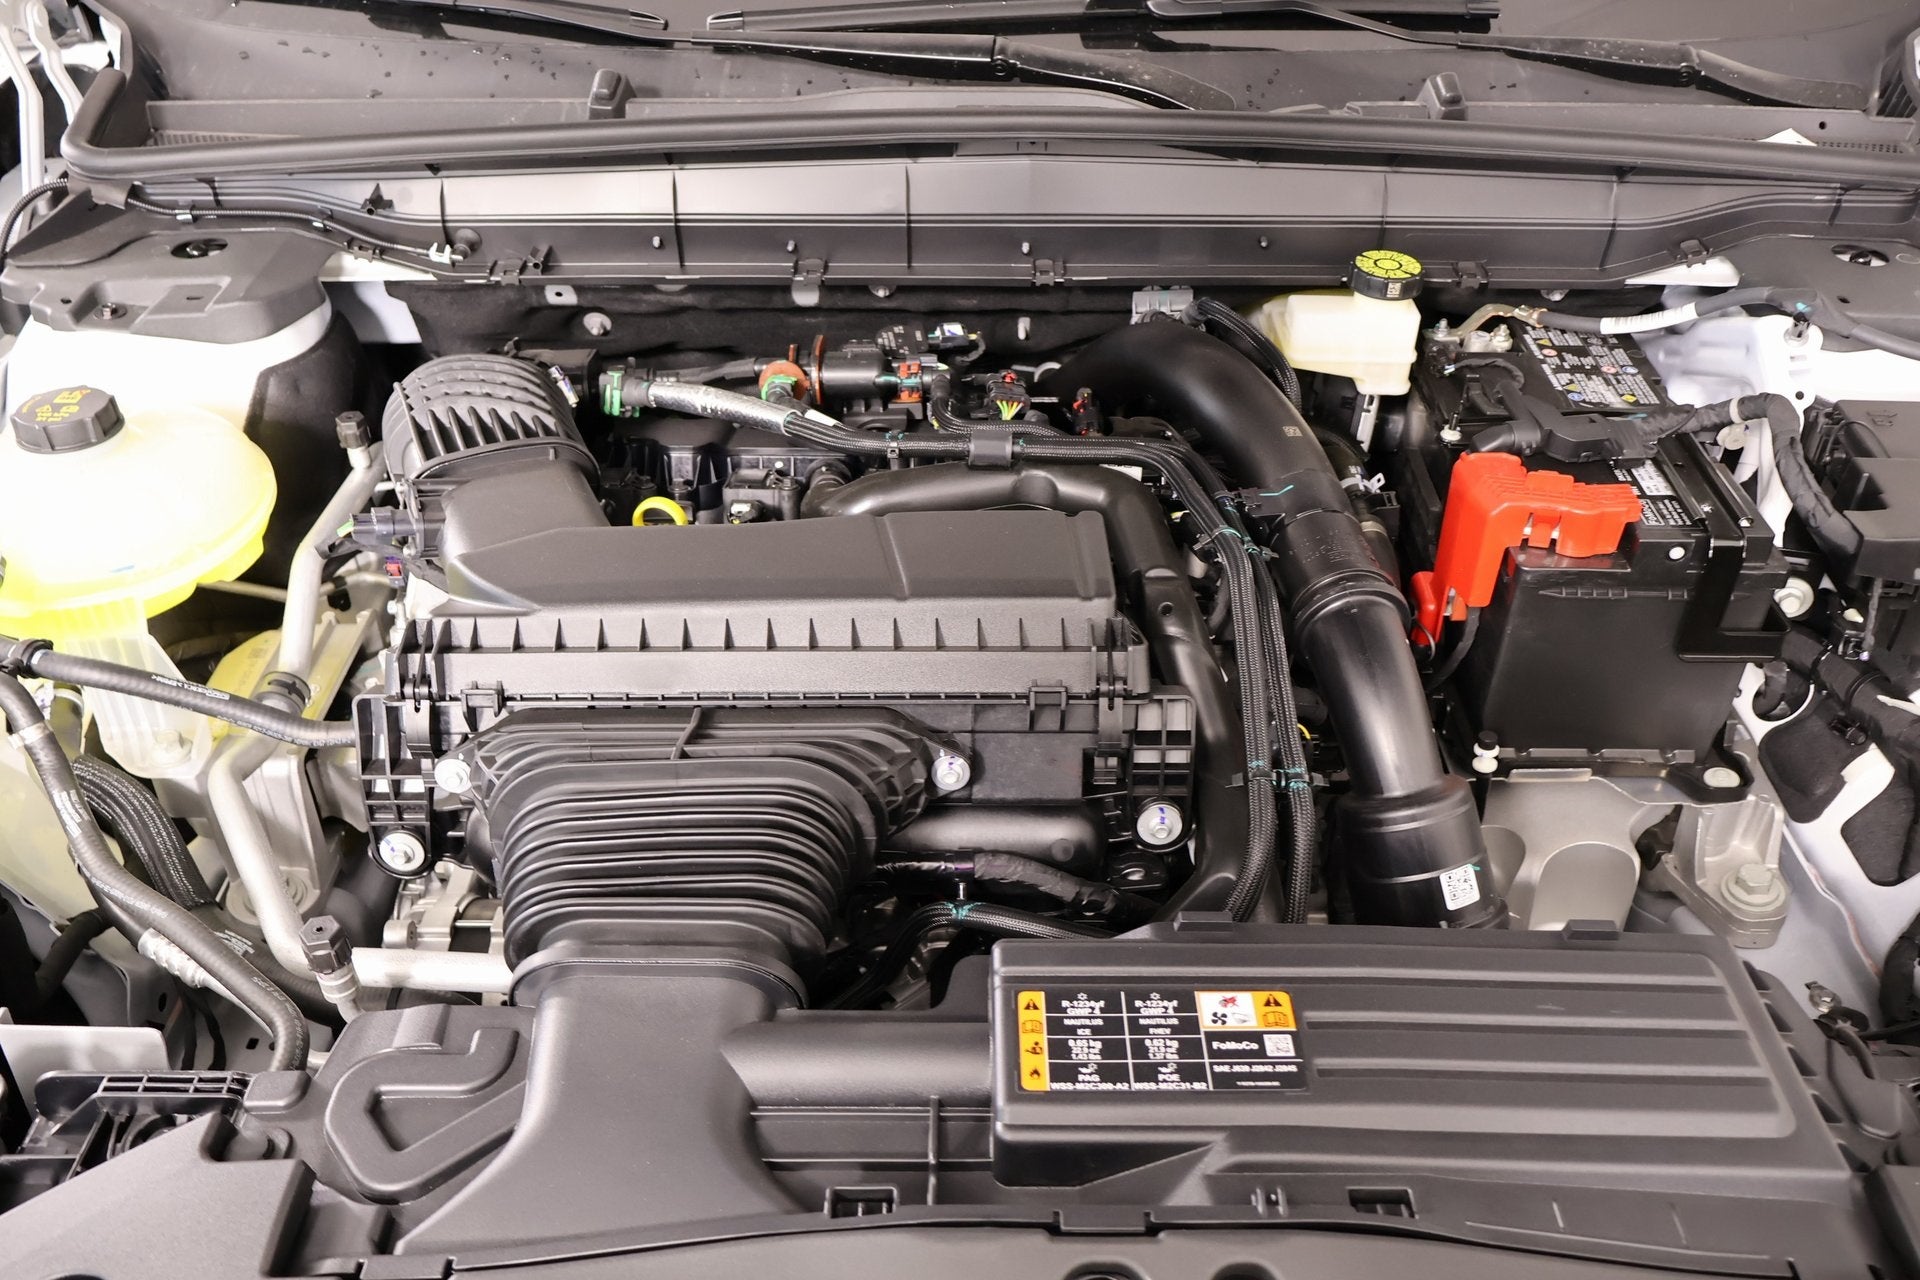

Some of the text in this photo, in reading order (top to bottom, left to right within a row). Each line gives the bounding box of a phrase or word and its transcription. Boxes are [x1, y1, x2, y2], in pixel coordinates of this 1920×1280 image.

[1061, 1000, 1105, 1009] R-1234yf
[1134, 999, 1179, 1008] R-1234yf
[1138, 1017, 1179, 1025] NAUTILUS
[1089, 1039, 1102, 1049] kg
[1165, 1038, 1179, 1048] kg
[1212, 1041, 1259, 1050] FoMoCo
[1212, 1064, 1231, 1072] SAE
[1077, 1073, 1101, 1082] PAG
[1157, 1073, 1181, 1082] POE
